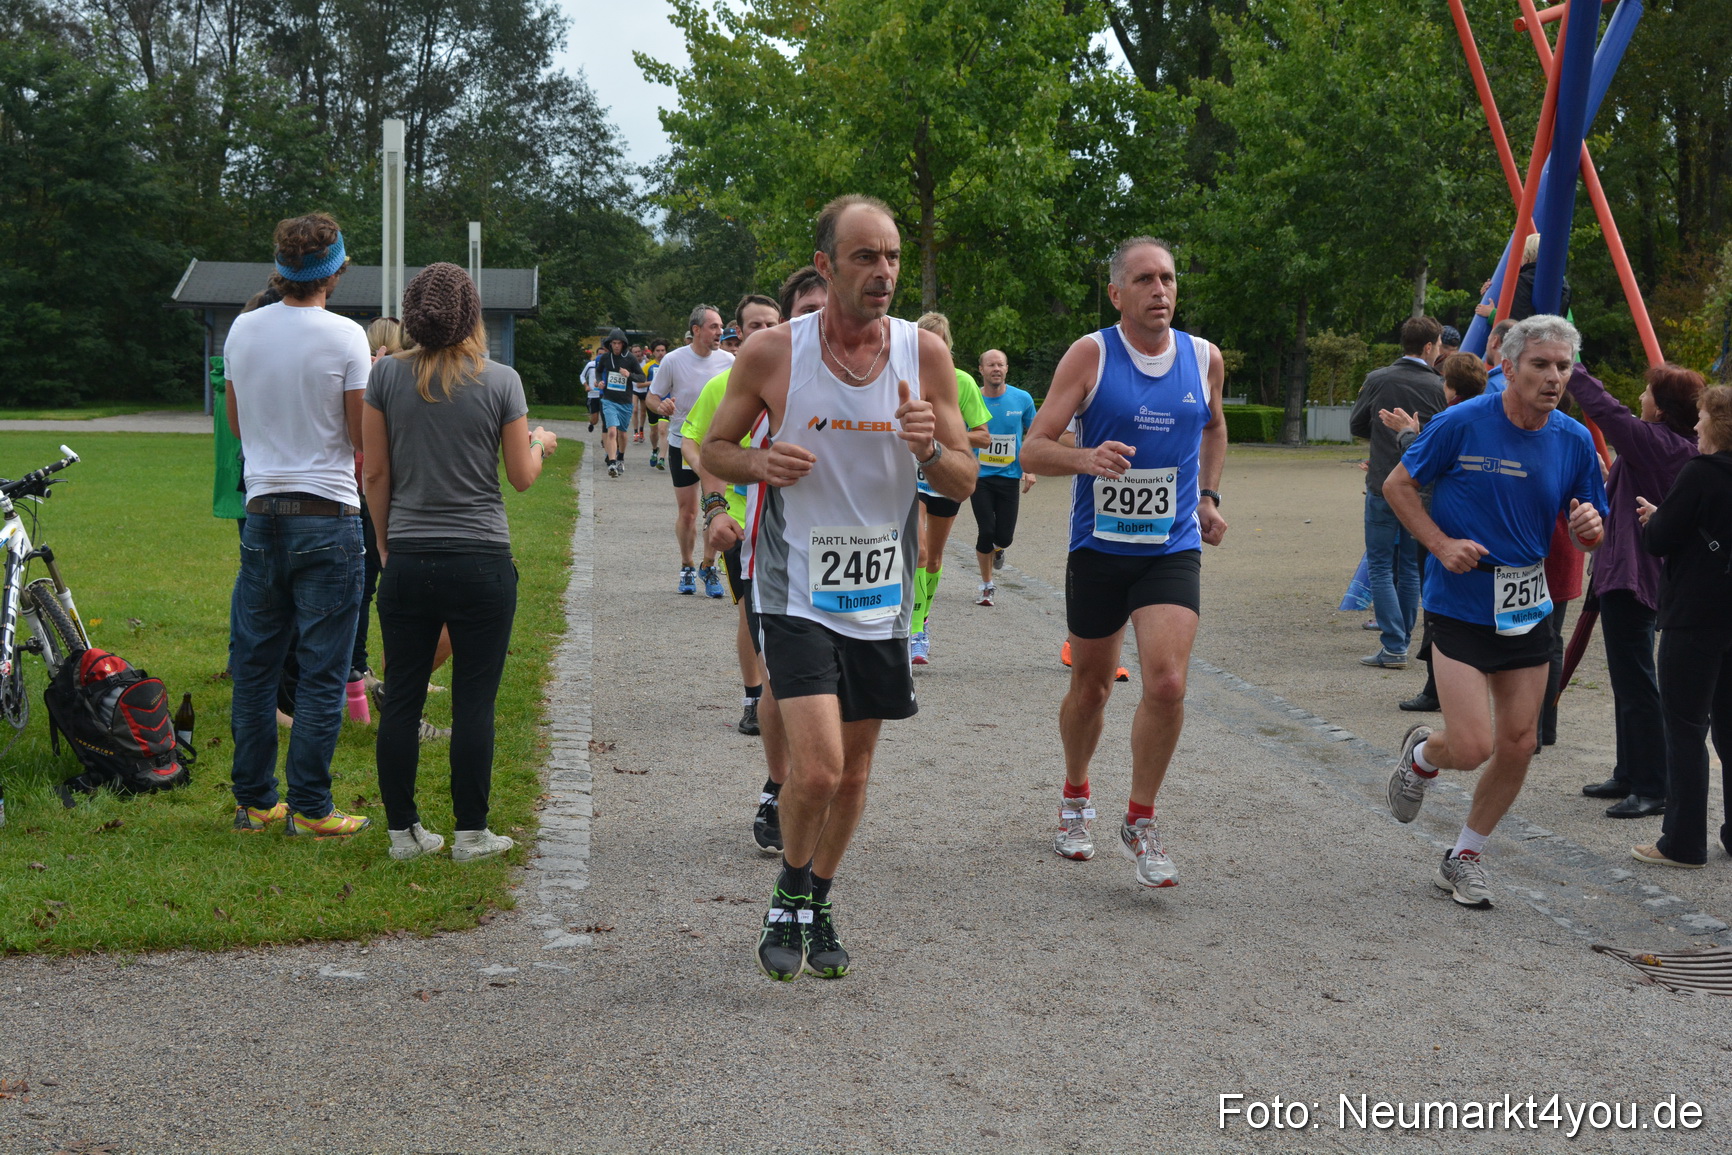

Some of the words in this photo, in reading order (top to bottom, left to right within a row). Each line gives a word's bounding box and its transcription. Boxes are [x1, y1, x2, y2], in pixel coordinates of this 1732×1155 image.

[609, 376, 626, 385] 2543
[831, 419, 896, 432] KLEBL
[1134, 415, 1175, 425] RAMSAUER
[1138, 424, 1170, 432] Allersberg
[1124, 476, 1163, 484] Neumarkt
[1102, 486, 1169, 515] 2923
[1117, 521, 1153, 533] Robert
[812, 536, 847, 545] PARTL
[849, 533, 890, 545] Neumarkt
[821, 546, 896, 586] 2467
[1502, 572, 1546, 609] 2572
[836, 594, 882, 609] Thomas
